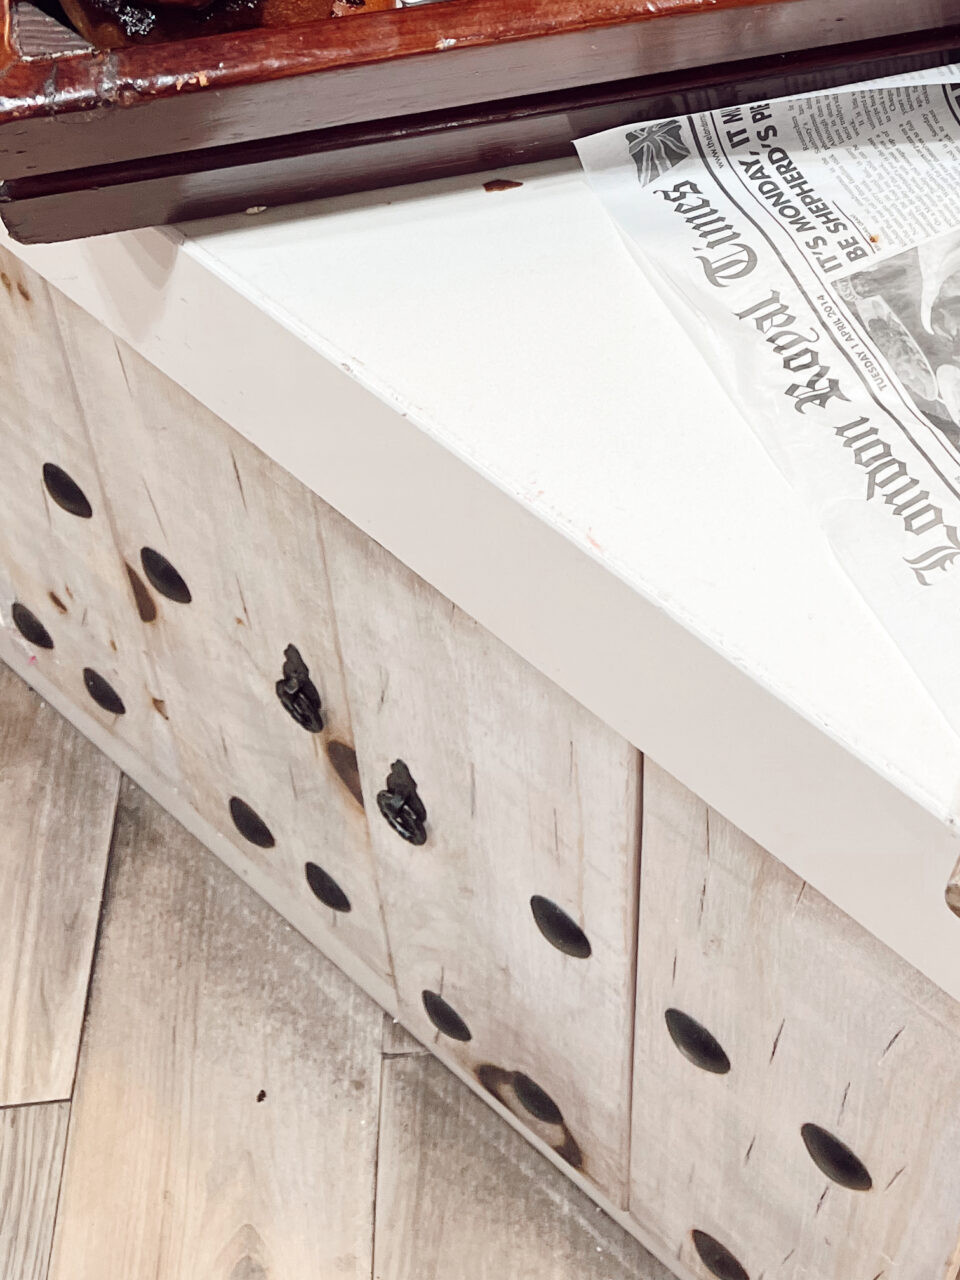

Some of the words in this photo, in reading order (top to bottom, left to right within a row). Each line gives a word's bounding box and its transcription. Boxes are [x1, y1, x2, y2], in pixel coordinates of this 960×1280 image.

[726, 128, 751, 149] IT
[738, 150, 816, 233] MONDAY,
[756, 124, 848, 235] SHEPHERD'S
[653, 180, 758, 288] Times
[837, 236, 870, 263] BE
[805, 235, 843, 274] IT'S
[817, 295, 837, 318] 2014
[833, 317, 855, 342] APRIL
[732, 289, 852, 414] Royal
[855, 351, 887, 391] TUESDAY
